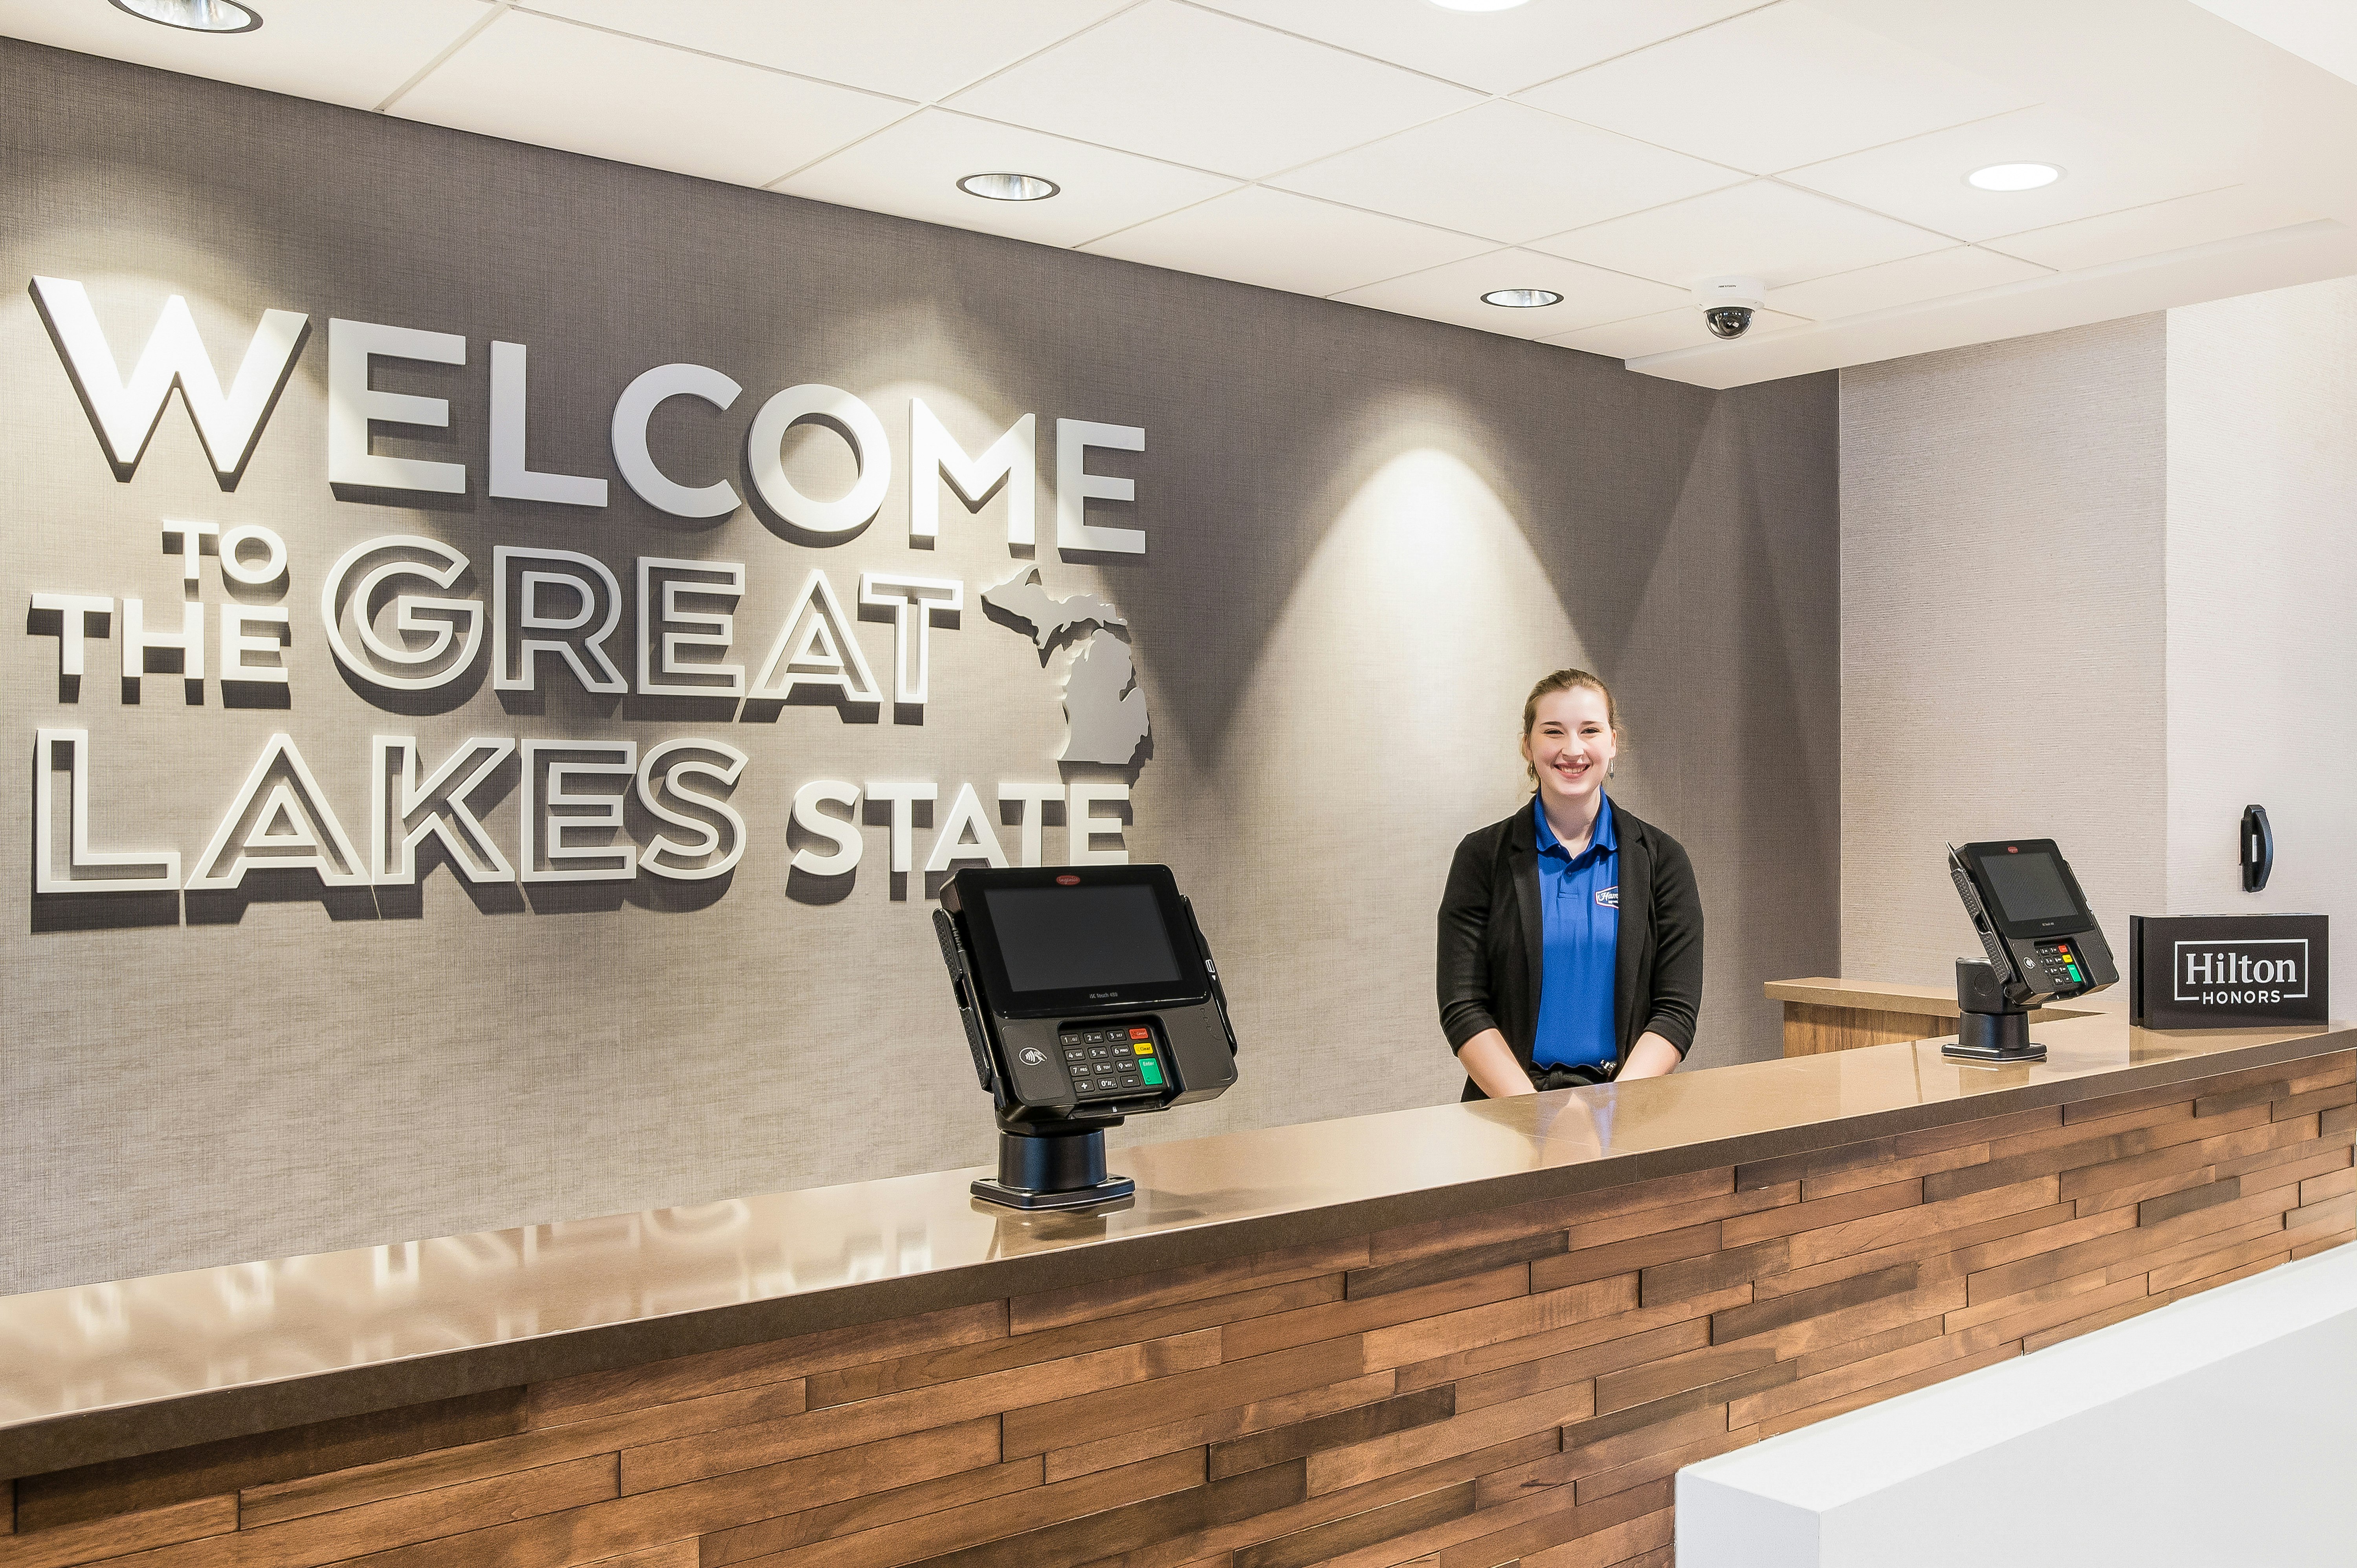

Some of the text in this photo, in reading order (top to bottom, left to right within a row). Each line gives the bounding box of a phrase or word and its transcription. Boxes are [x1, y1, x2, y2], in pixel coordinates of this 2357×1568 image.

[29, 275, 1146, 554] WELCOME
[163, 519, 288, 584] TO
[31, 535, 964, 704] THE GREAT
[36, 729, 1130, 893] LAKES STATE
[2186, 952, 2297, 984] Hilton
[2202, 990, 2281, 1005] HONORS
